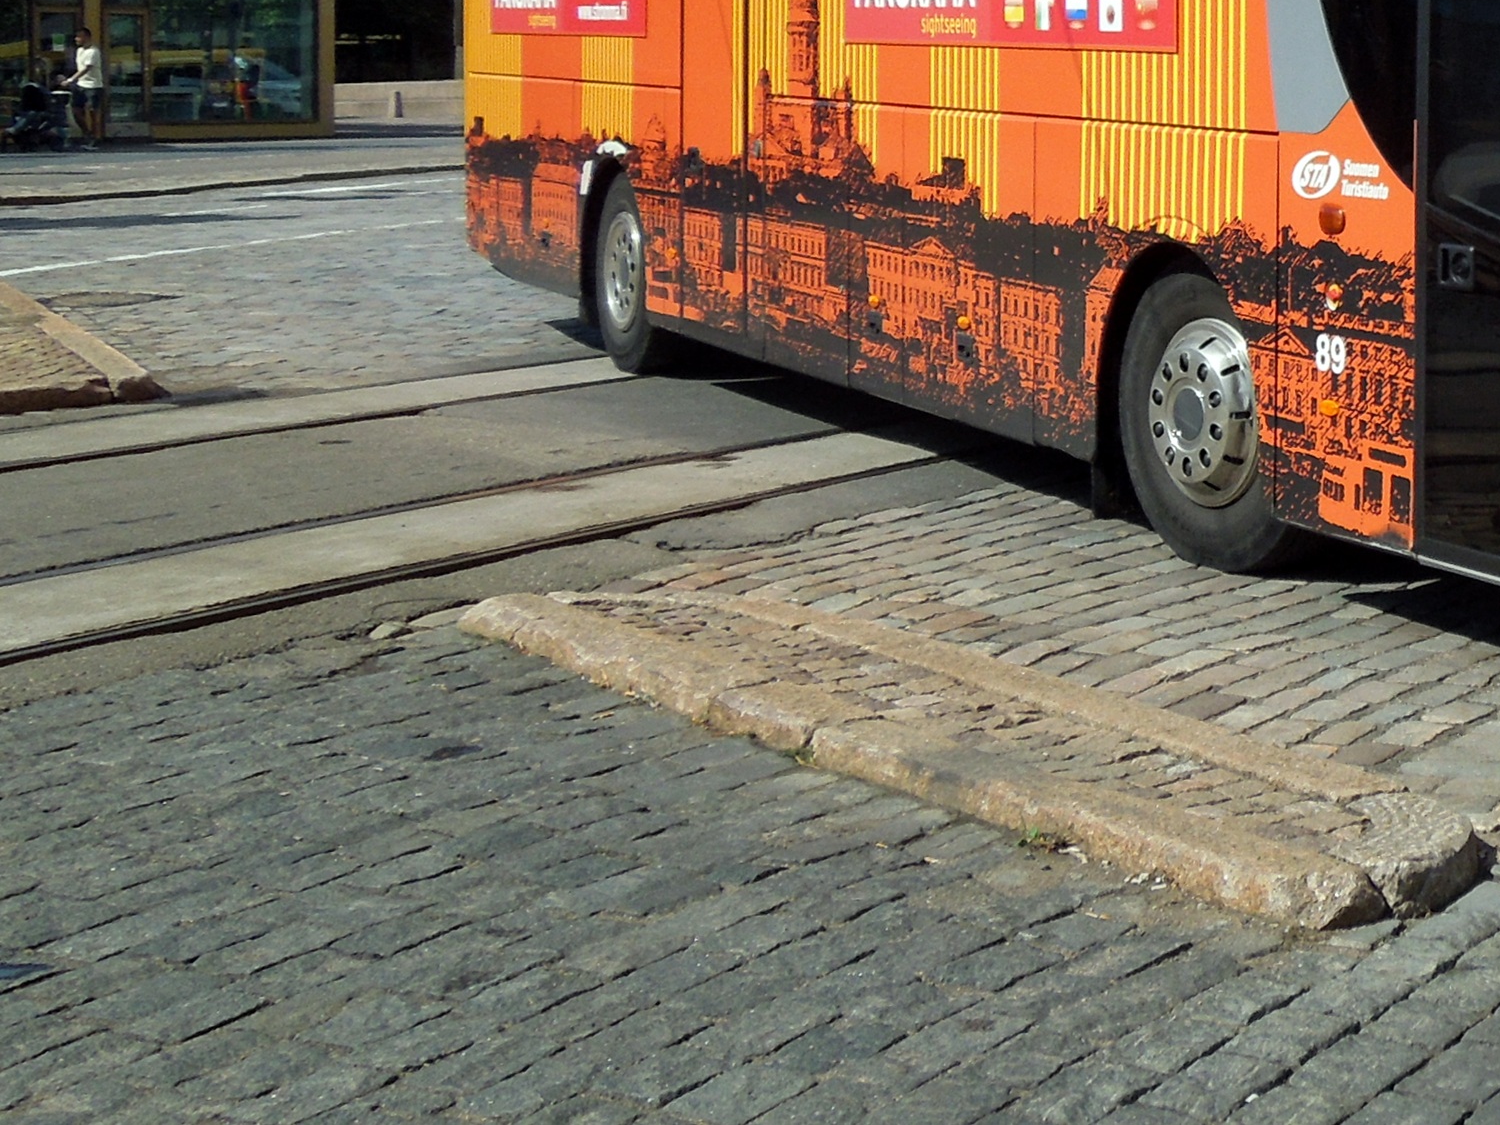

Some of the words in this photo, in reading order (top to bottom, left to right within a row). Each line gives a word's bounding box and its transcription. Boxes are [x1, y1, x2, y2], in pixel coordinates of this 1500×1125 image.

[921, 13, 977, 38] sightseeing
[1342, 159, 1379, 178] Suomen
[1315, 333, 1346, 374] 89
